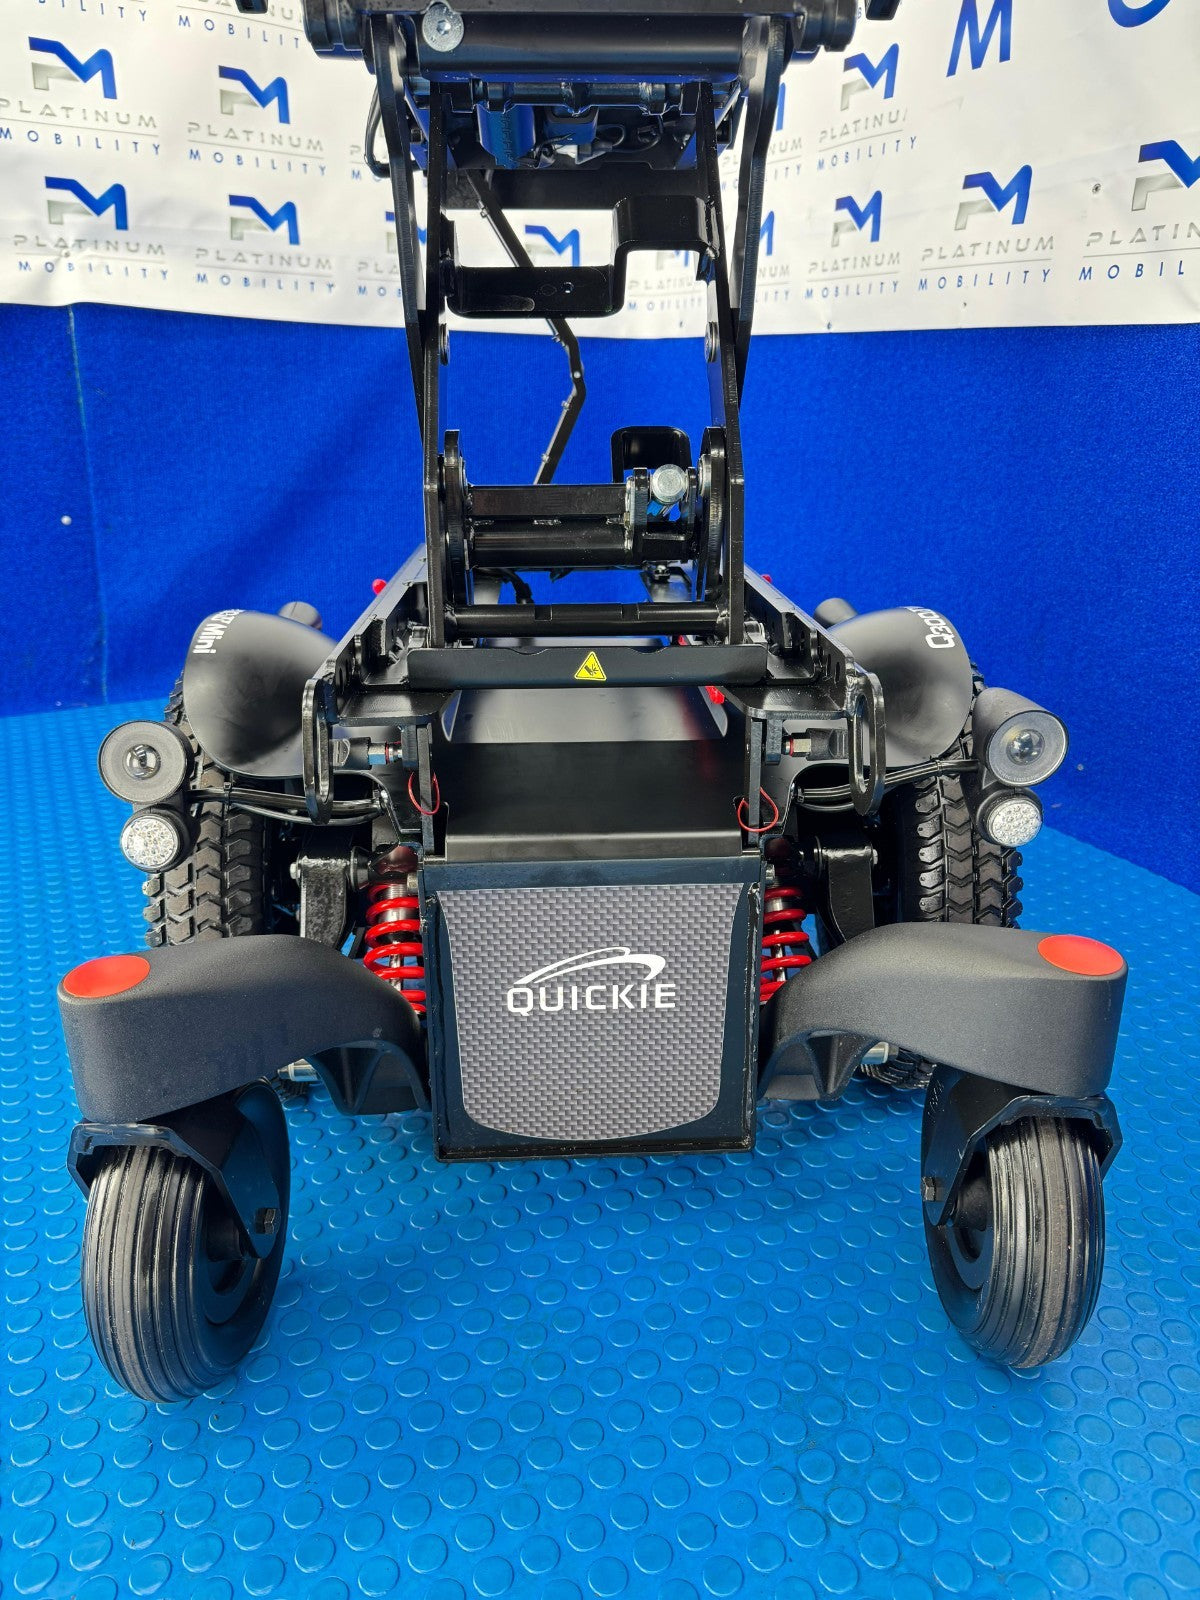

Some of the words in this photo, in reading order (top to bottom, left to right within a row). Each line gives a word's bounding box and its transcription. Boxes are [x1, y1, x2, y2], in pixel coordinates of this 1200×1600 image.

[178, 15, 300, 48] MOBILIT
[0, 98, 157, 128] PLATINUM
[0, 127, 160, 155] MOBILITY
[188, 121, 324, 151] PLATINUM
[189, 149, 326, 176] MOBILITY
[817, 136, 917, 170] MOBILITY
[14, 235, 166, 256] PLATINUM
[195, 247, 332, 270] PLATINUM
[921, 235, 1055, 262] PLATINUM
[19, 261, 168, 281] MOBILITY
[808, 251, 900, 274] PLATINUM
[1078, 260, 1185, 281] MOBIL
[196, 272, 335, 293] MOBILITY
[805, 280, 899, 299] MOBILITY
[918, 268, 1051, 291] MOBILITY
[192, 623, 227, 654] Mini
[505, 983, 677, 1016] QUICKIE
